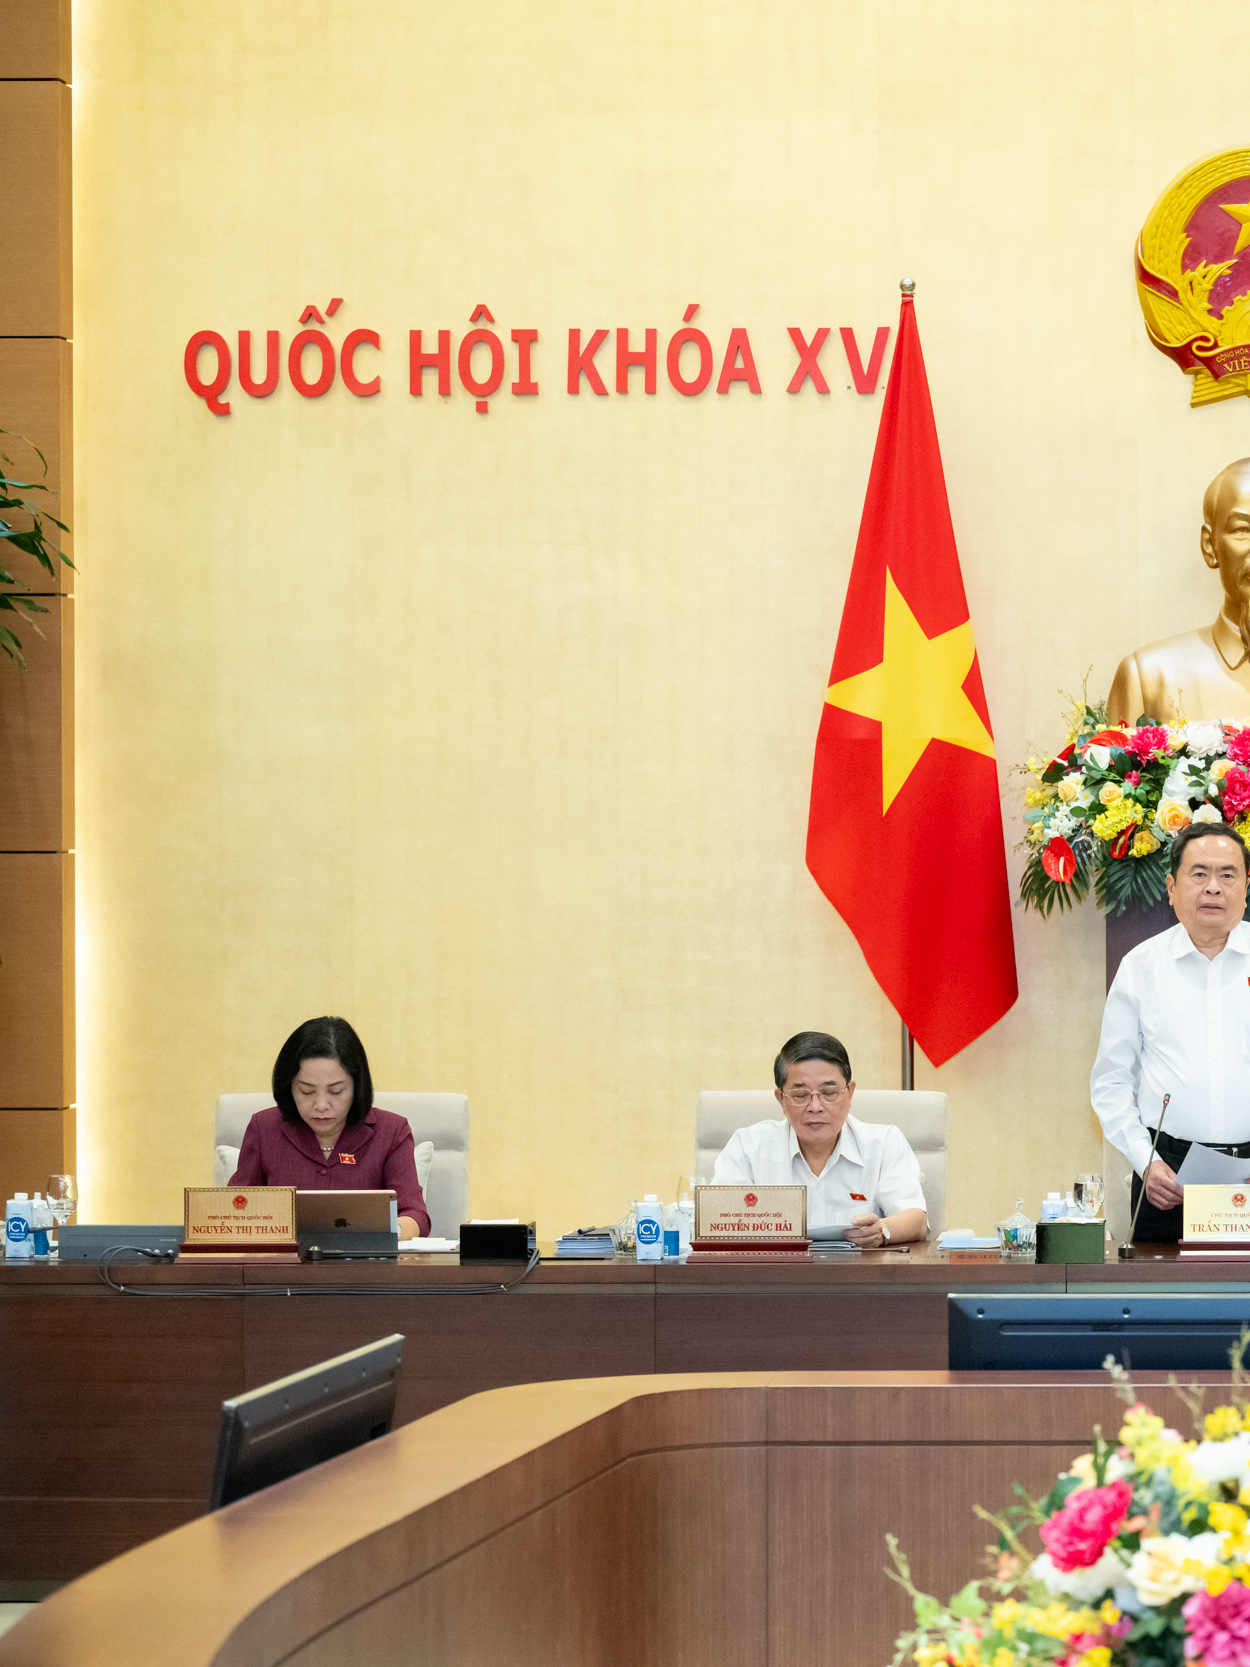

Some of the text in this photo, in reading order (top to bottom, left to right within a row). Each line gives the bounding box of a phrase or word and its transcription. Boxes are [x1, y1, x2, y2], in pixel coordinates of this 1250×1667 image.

[184, 298, 891, 415] QUỐC HỘI KHÓA XV
[8, 1221, 27, 1232] ICY
[192, 1221, 289, 1236] NGUYỄN THỊ THANH
[639, 1223, 658, 1234] ICY
[752, 1221, 773, 1231] ĐỨC
[775, 1220, 792, 1231] HẢI
